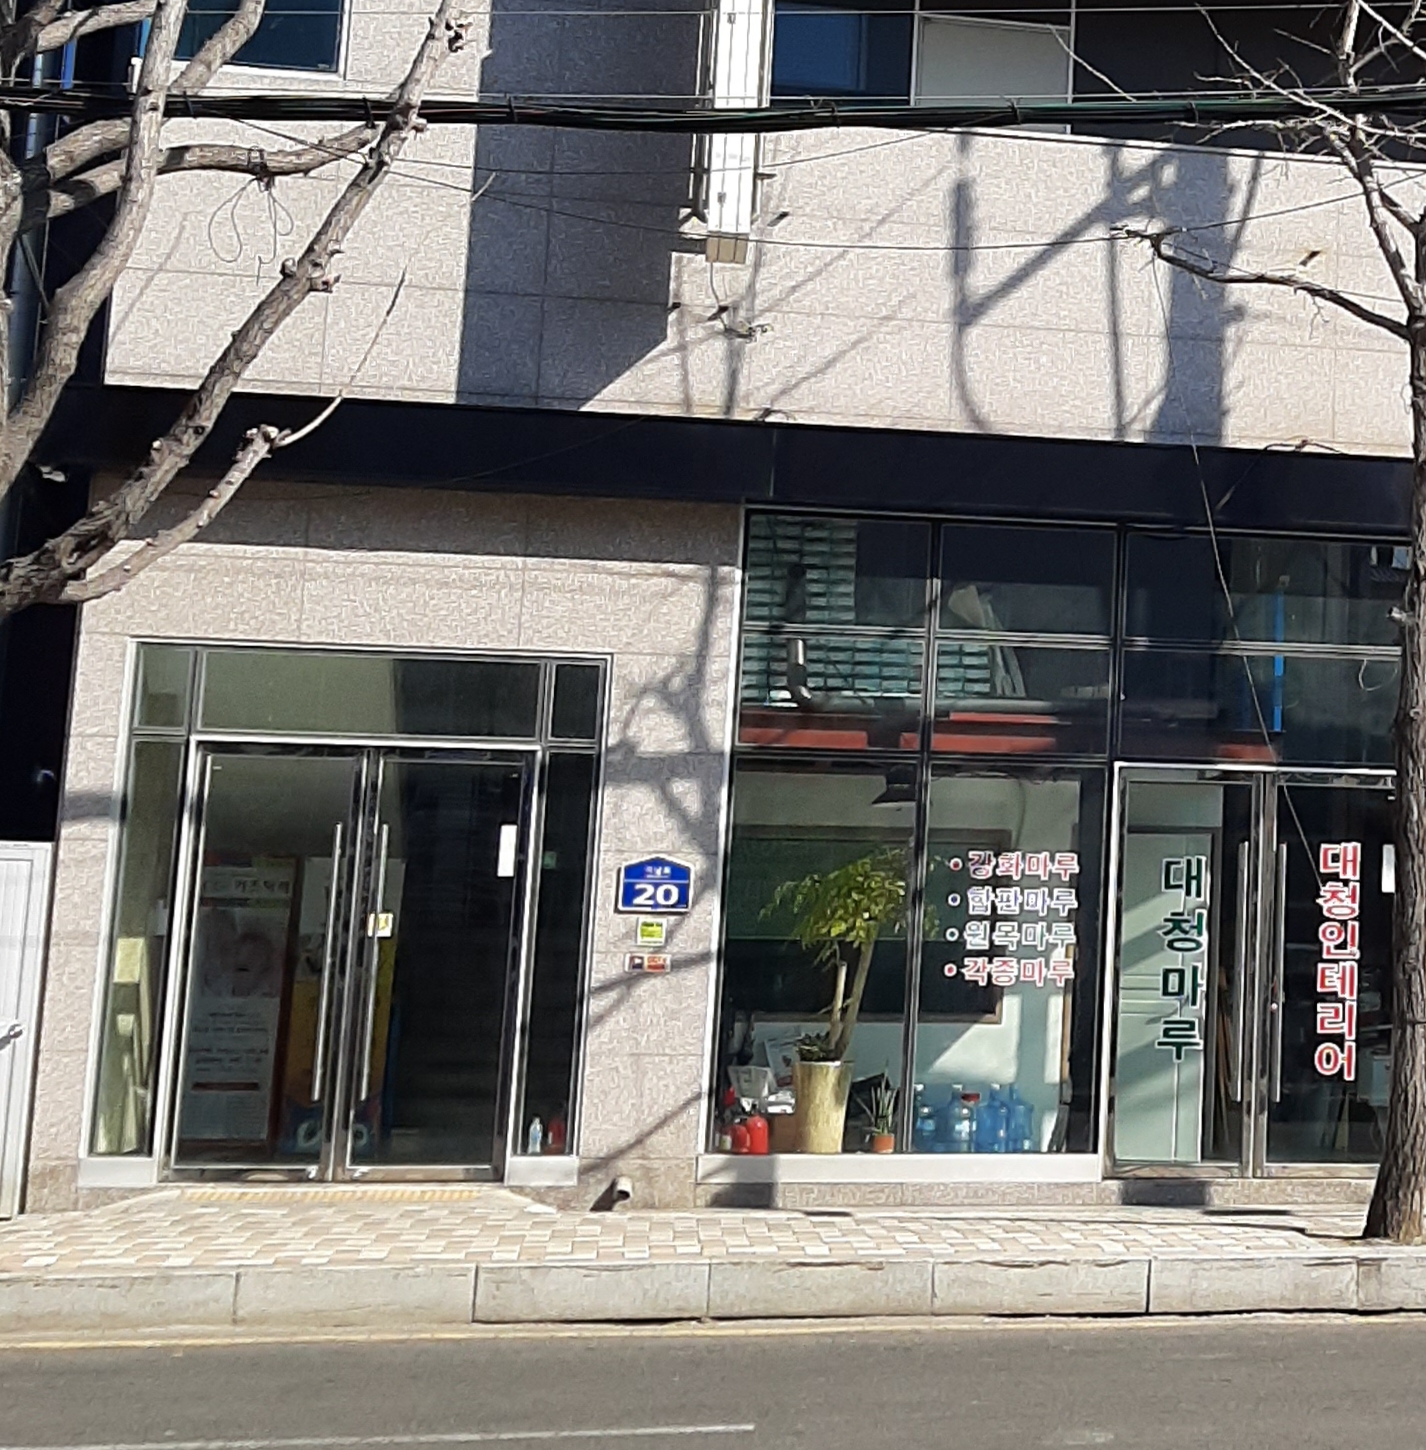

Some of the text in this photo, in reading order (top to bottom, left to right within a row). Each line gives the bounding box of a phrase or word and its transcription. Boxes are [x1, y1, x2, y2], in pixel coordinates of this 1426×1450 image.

[967, 850, 1080, 881] 강화마루
[632, 883, 680, 906] 20
[967, 886, 1079, 917] 합판마루
[963, 920, 1077, 951] 원목마루
[960, 956, 1075, 988] 각종마루
[1154, 854, 1208, 1063] 대청마루
[1314, 841, 1362, 1081] 대청인테리어
